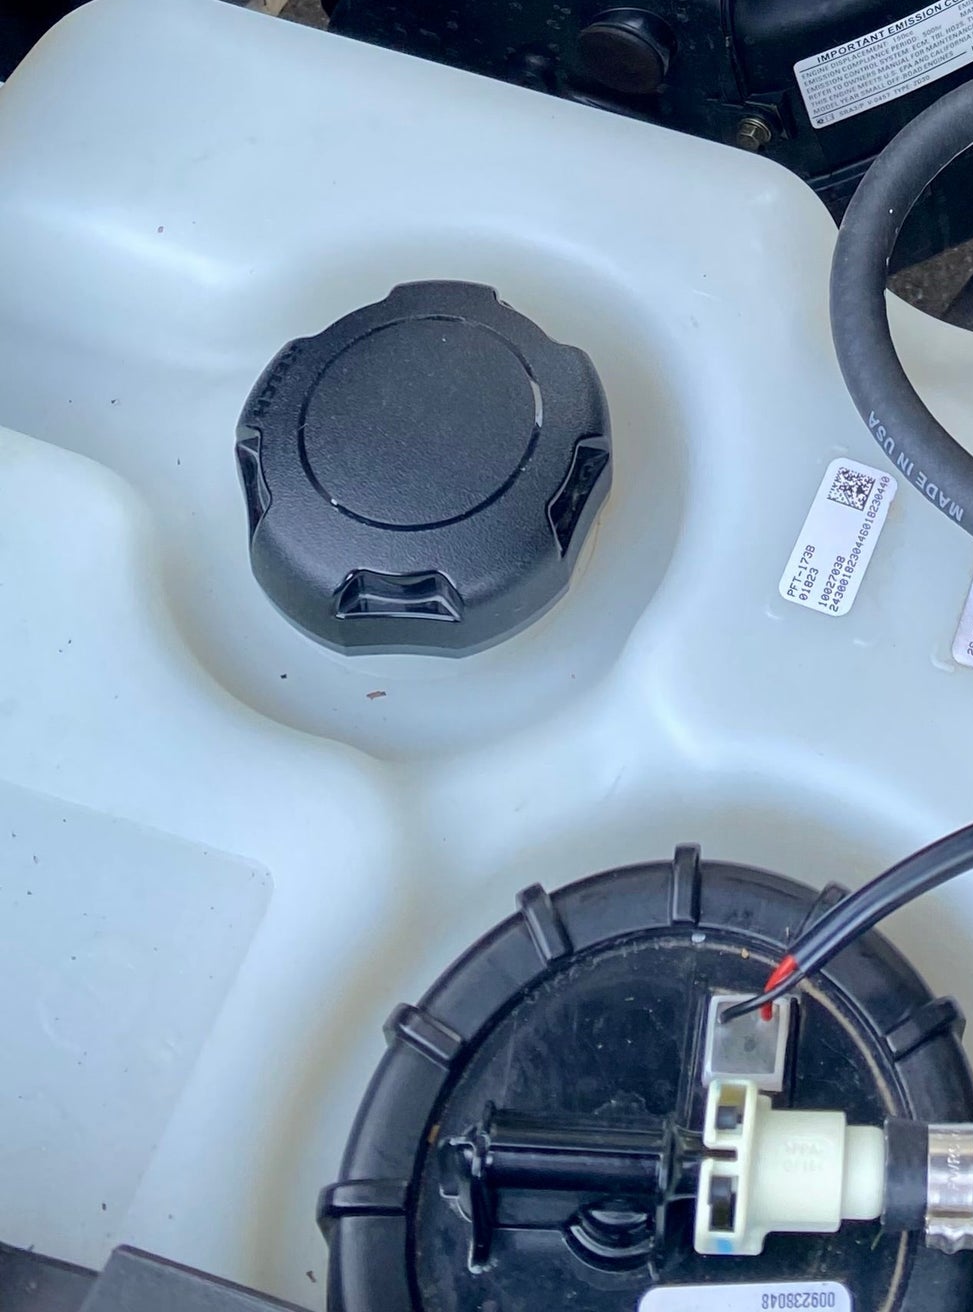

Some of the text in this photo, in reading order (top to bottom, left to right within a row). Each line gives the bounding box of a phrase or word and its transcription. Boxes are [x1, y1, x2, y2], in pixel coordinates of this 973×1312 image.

[816, 30, 886, 63] IMPORTANT
[887, 3, 943, 34] EMISSION
[803, 68, 841, 87] EMISSION
[841, 47, 891, 72] COMPLIANCE
[805, 75, 843, 94] EMISSION
[843, 60, 878, 79] CONTROL
[808, 87, 832, 101] REFER
[832, 83, 842, 91] TO
[843, 69, 876, 87] OWNERS
[877, 55, 909, 73] MANUAL
[909, 48, 925, 59] FOR
[810, 97, 827, 108] THIS
[828, 85, 856, 101] ENGINE
[857, 75, 882, 89] MEETS
[898, 62, 912, 72] EPA
[912, 54, 929, 66] AND
[929, 34, 972, 58] CALIFORNIA
[812, 51, 953, 115] MODEL YEAR SMALL OFF-ROAD ENGINES
[866, 410, 895, 455] USA
[898, 454, 914, 475] IN
[914, 473, 963, 522] MADE
[787, 544, 816, 598] PFT-173B
[799, 567, 819, 601] 01823
[817, 555, 846, 608] 10027038
